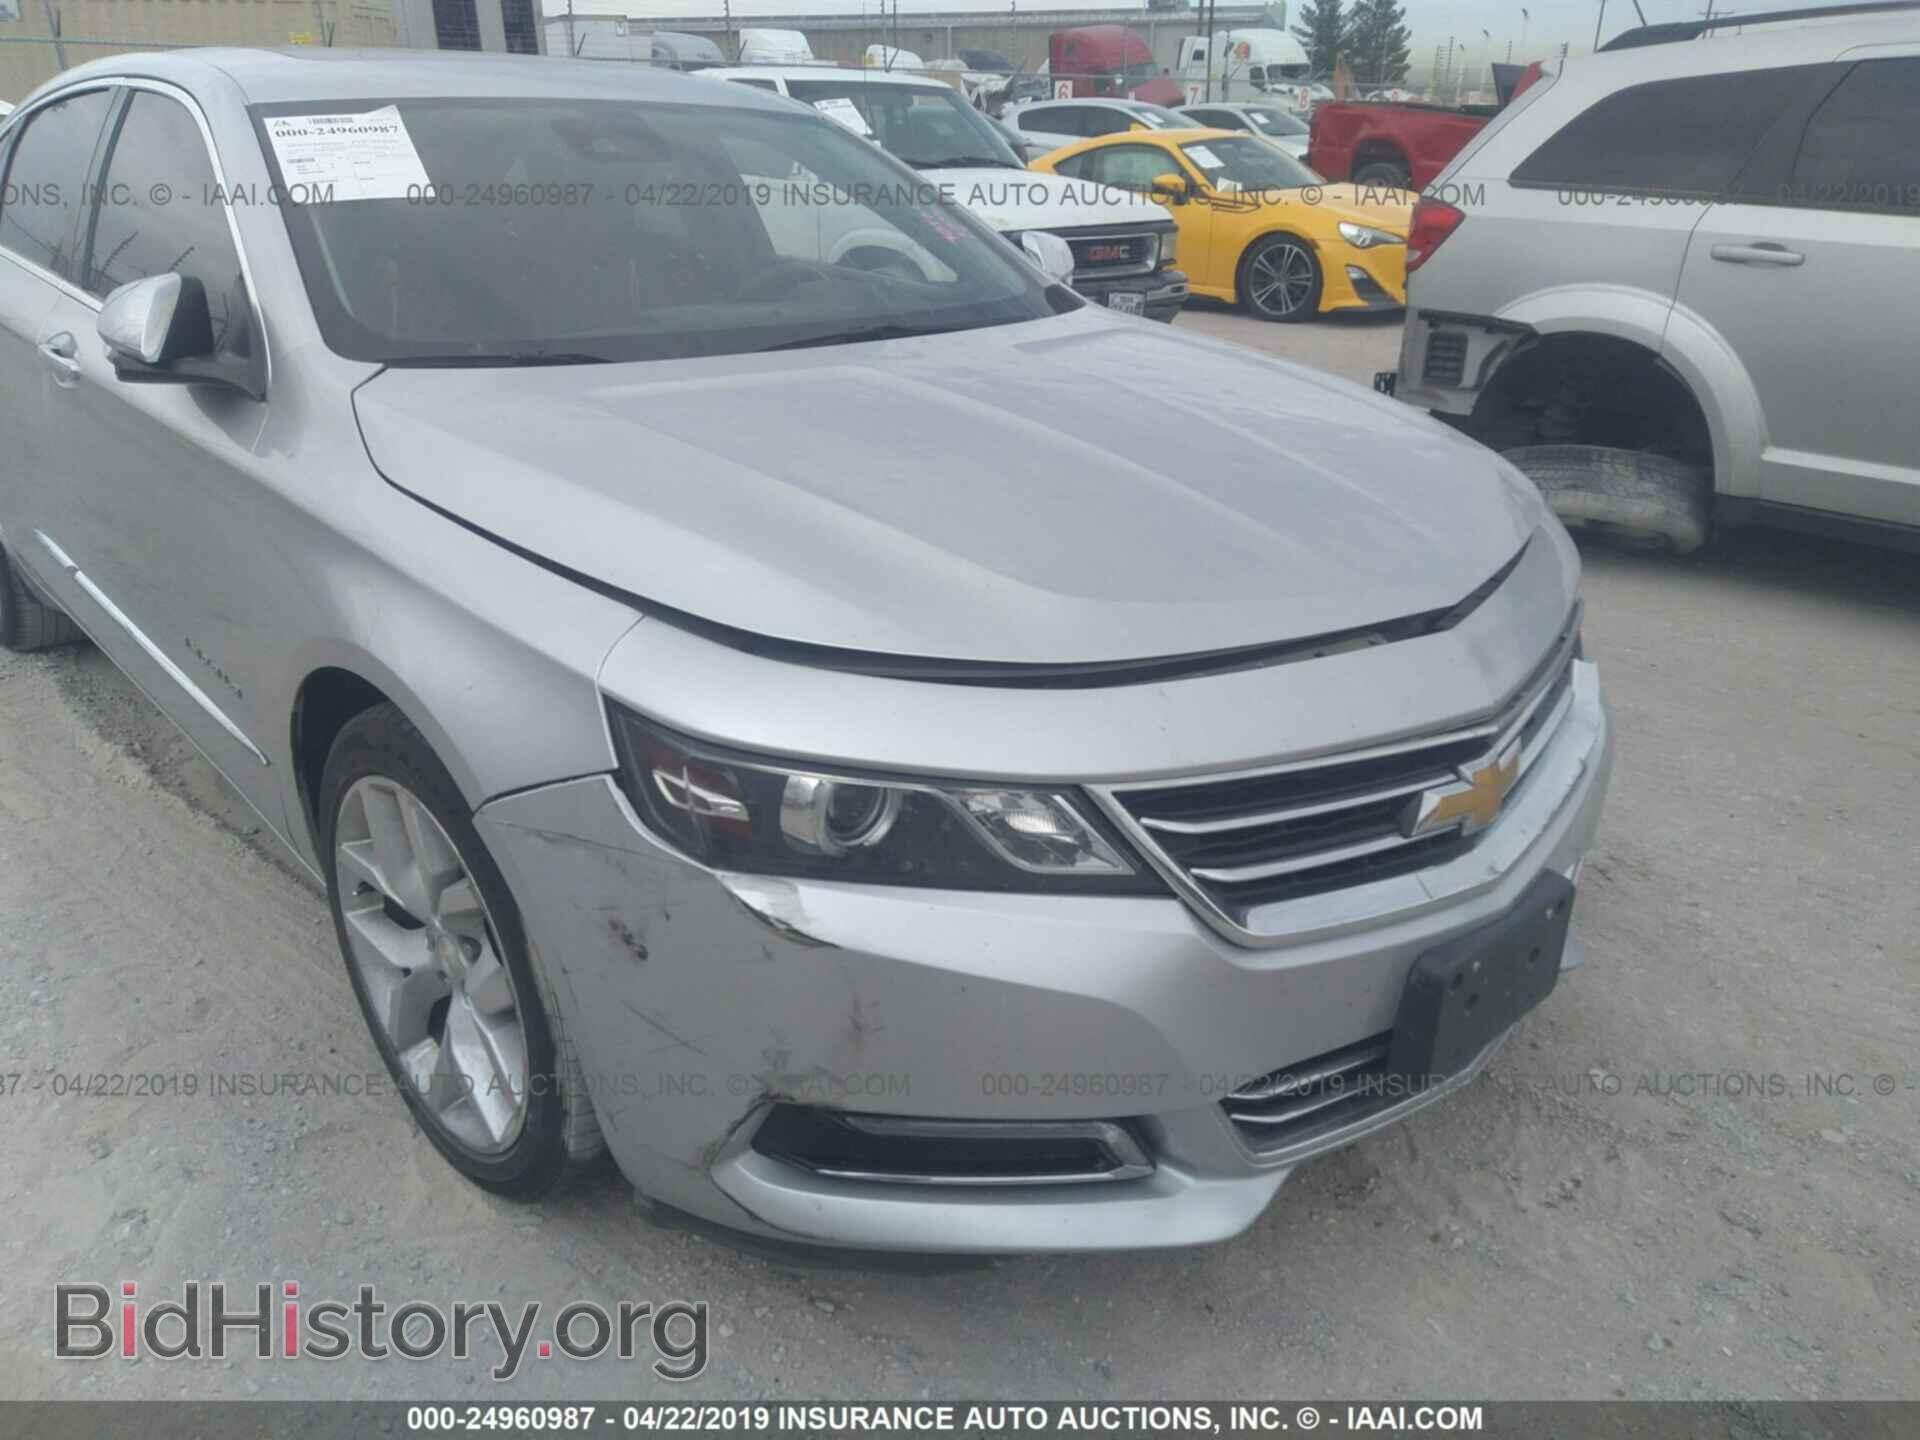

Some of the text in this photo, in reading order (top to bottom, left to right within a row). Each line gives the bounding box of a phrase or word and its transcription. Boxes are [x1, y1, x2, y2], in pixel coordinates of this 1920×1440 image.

[1189, 86, 1201, 105] 7
[275, 125, 399, 137] 000-24960987
[1088, 245, 1130, 262] GMC
